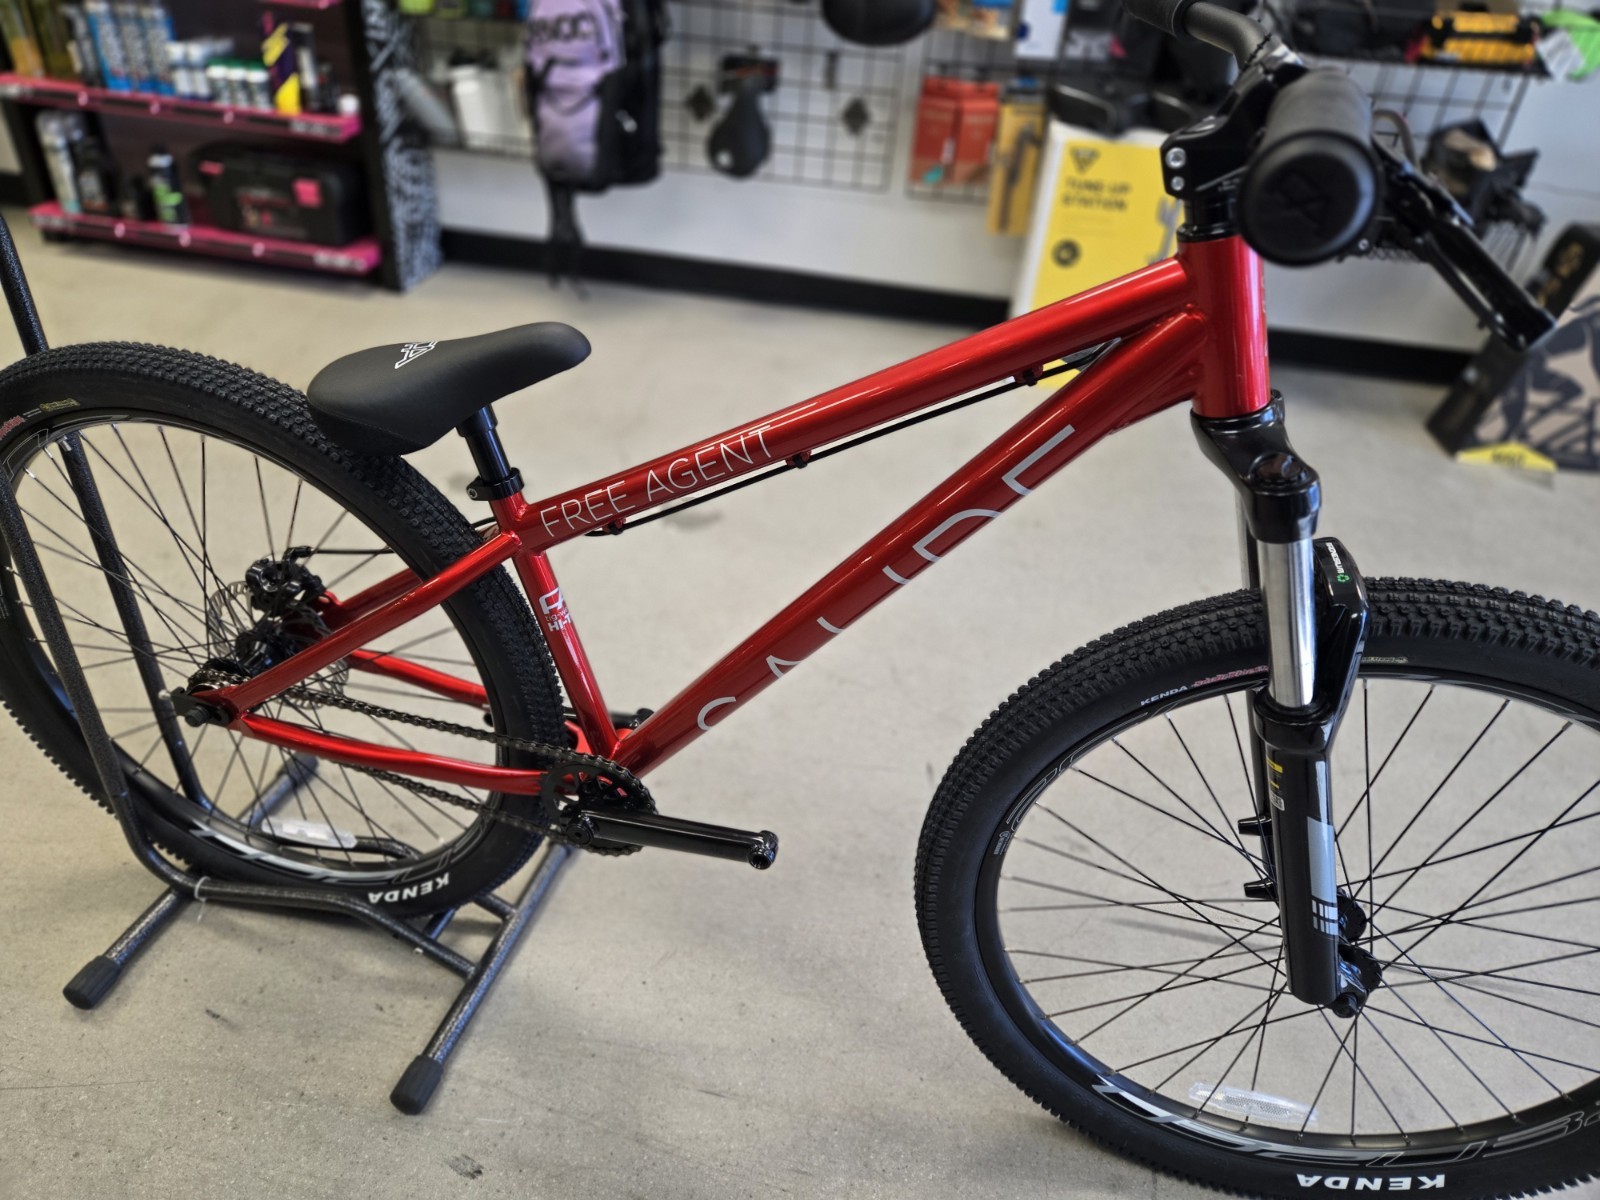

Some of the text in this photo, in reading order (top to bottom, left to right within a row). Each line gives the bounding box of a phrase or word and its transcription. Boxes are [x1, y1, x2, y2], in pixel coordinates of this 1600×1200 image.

[540, 425, 772, 537] FREE AGENT
[1140, 685, 1188, 706] KENDA
[368, 872, 449, 904] KENDA
[1296, 1174, 1446, 1191] KENDA
